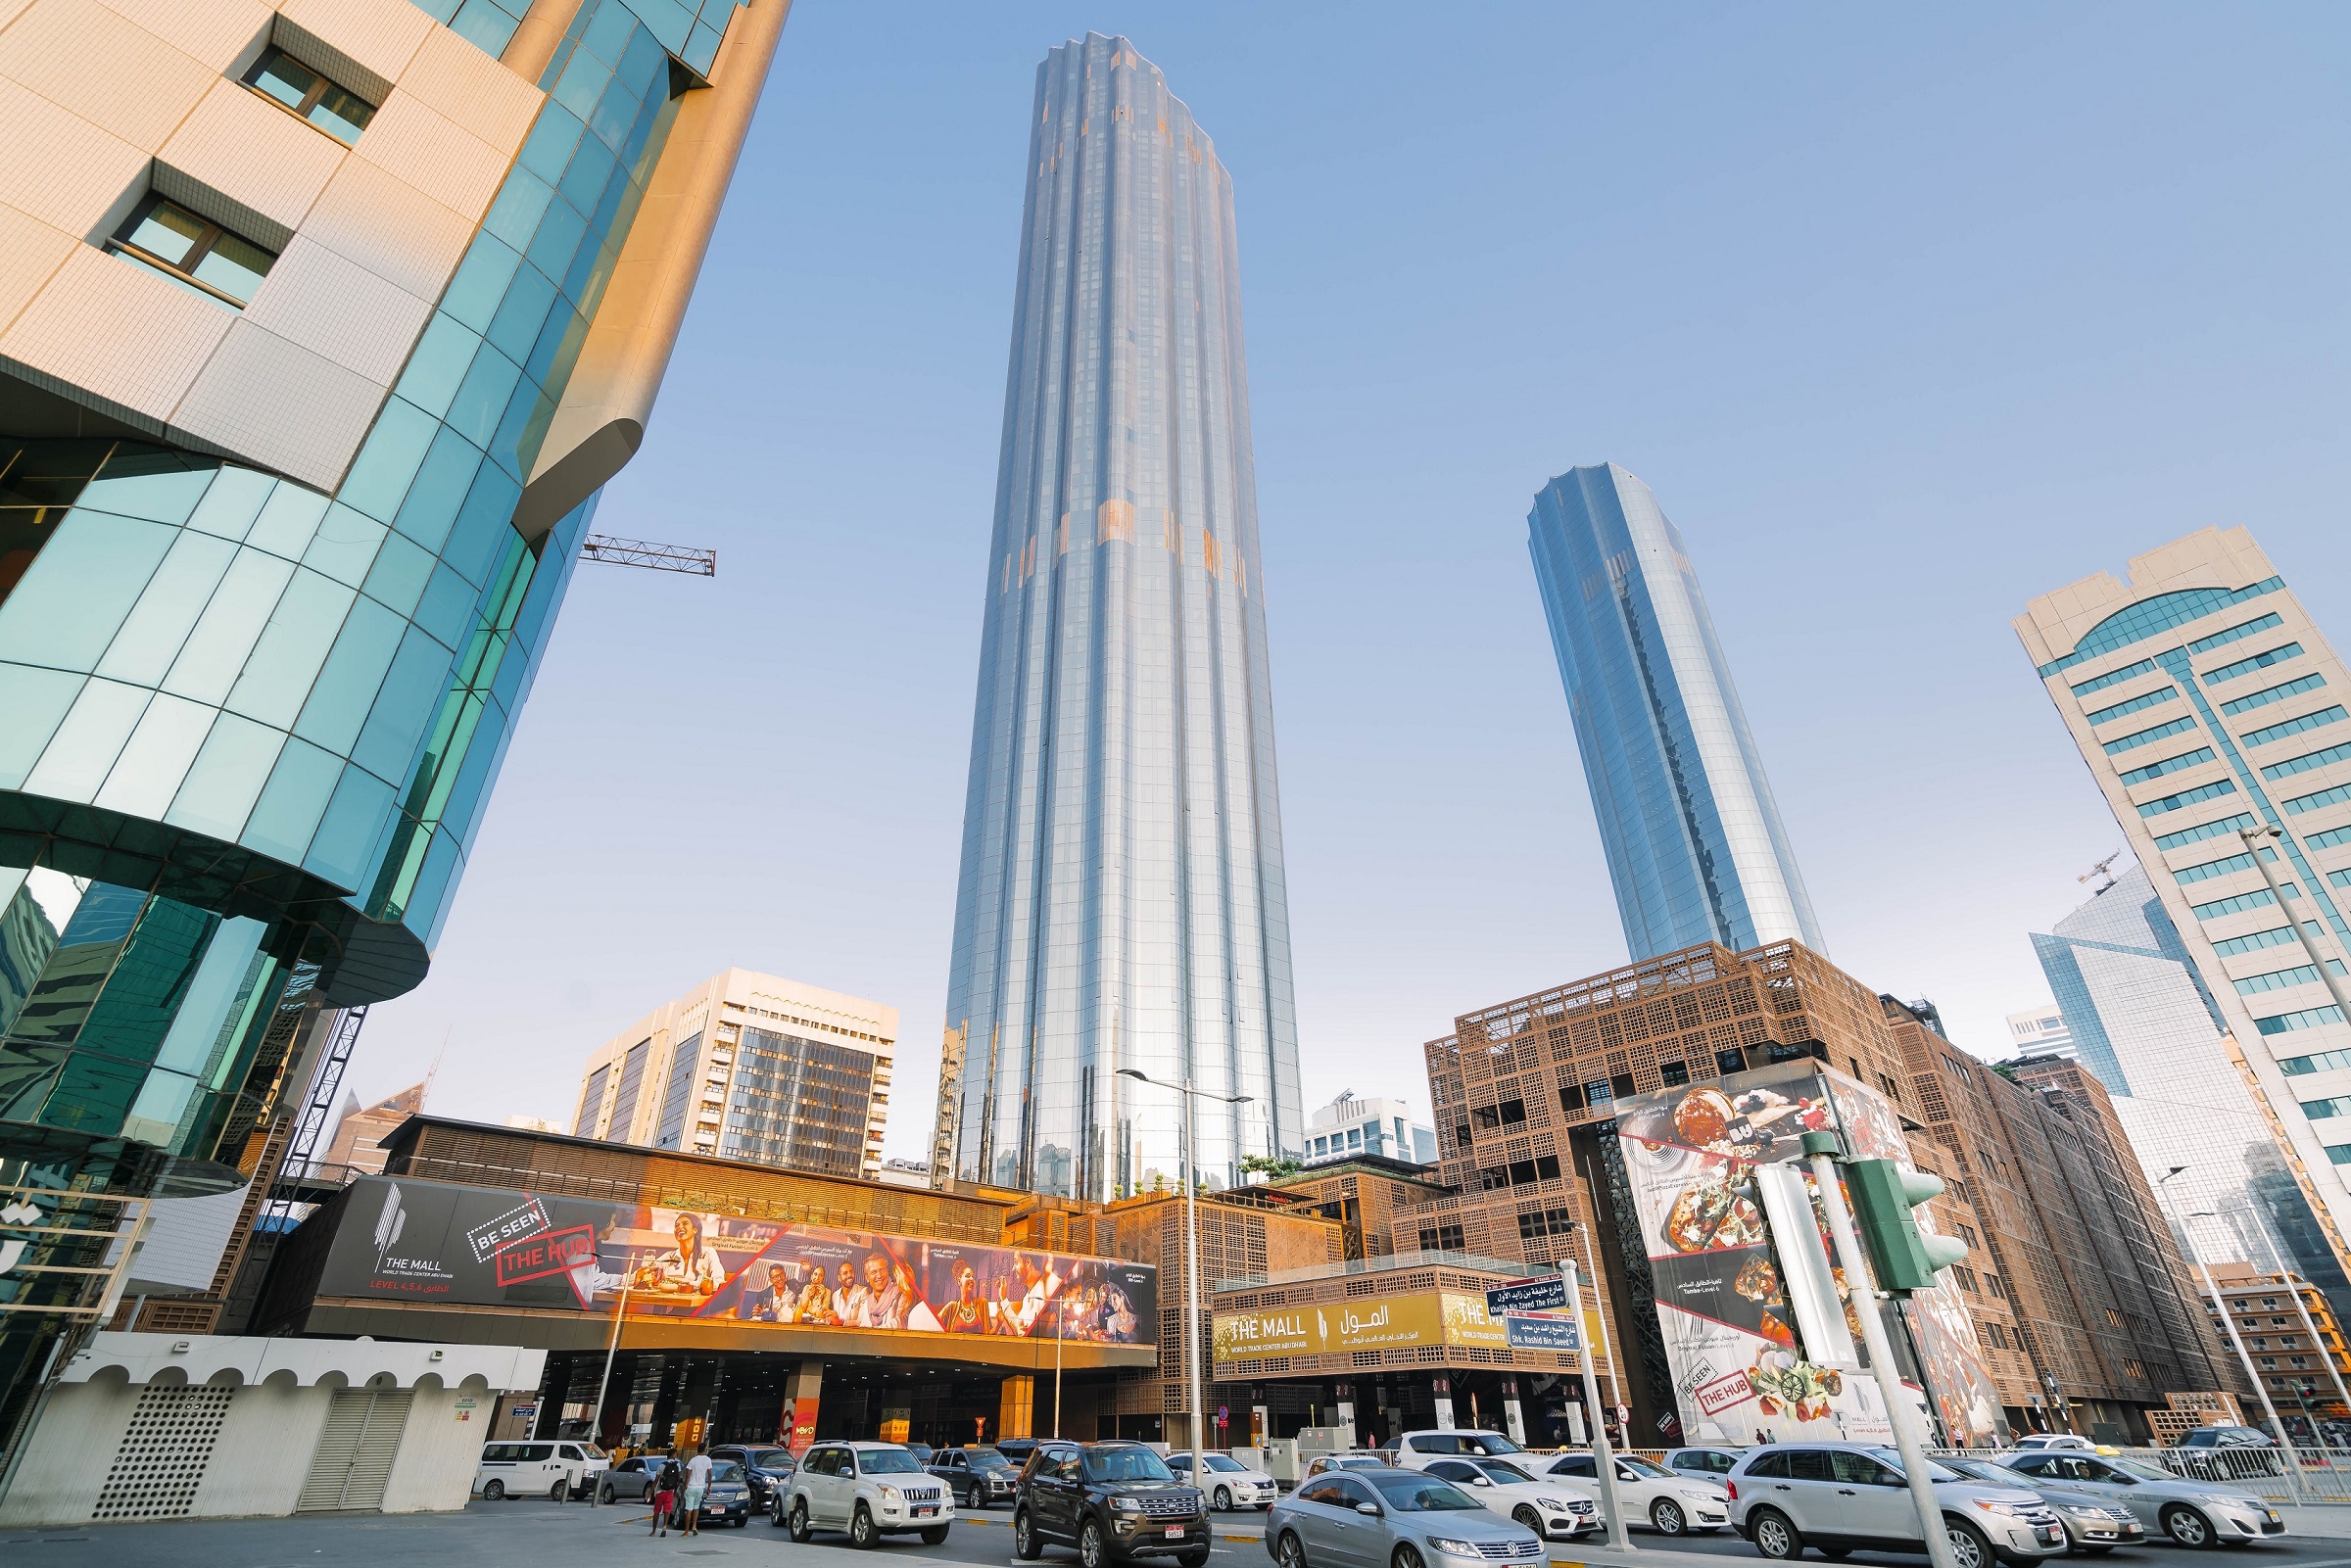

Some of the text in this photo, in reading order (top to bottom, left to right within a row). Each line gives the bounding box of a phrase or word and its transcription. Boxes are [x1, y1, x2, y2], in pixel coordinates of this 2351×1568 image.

[1269, 1194, 1289, 1204] Nando's
[477, 1210, 541, 1251] BE SEEN
[504, 1237, 588, 1271] THE HUB
[386, 1258, 442, 1271] THE MALL
[369, 1280, 422, 1291] LEVEL 4,5,6
[423, 1284, 450, 1293] الطابق
[1497, 1284, 1562, 1302] شارع خليفة بن زايد الأول
[1683, 1286, 1715, 1295] Tamba-Level
[1490, 1304, 1509, 1313] Khalifa
[1518, 1301, 1535, 1310] Zayed
[1535, 1299, 1546, 1307] The
[1546, 1297, 1559, 1306] First
[1340, 1305, 1389, 1335] المول
[1458, 1302, 1486, 1325] THE
[1230, 1315, 1307, 1341] THE MALL
[1520, 1323, 1576, 1337] شارع الشيخ راشد بن سعيد
[1263, 1343, 1281, 1352] CENTER
[1524, 1336, 1543, 1345] Rashid
[1684, 1364, 1711, 1395] BE SEEN
[1702, 1379, 1748, 1406] THE HUB
